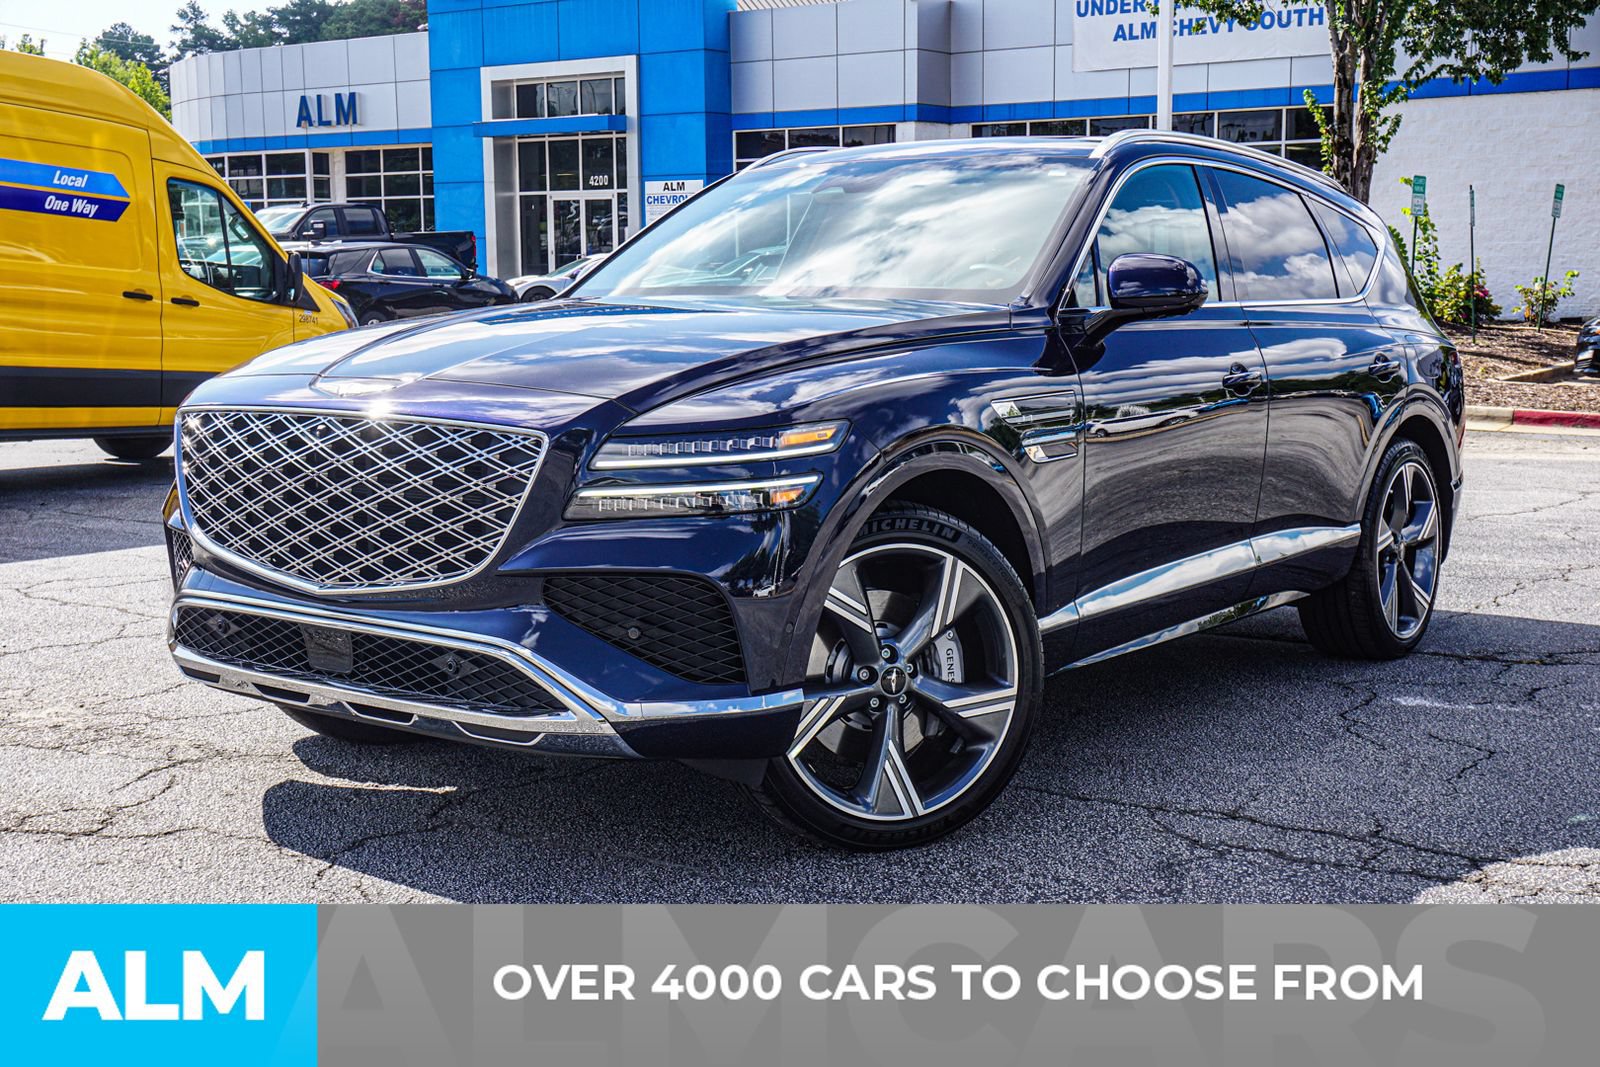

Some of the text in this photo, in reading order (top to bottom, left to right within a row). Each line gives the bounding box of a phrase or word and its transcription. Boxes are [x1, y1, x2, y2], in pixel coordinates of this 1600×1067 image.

[1076, 0, 1147, 17] UNDER
[1113, 21, 1157, 42] ALM
[296, 91, 358, 128] ALM
[53, 170, 88, 188] Local
[589, 174, 609, 187] 4200
[663, 181, 686, 192] ALM
[44, 195, 99, 218] One Way
[646, 194, 689, 205] CHEVRO
